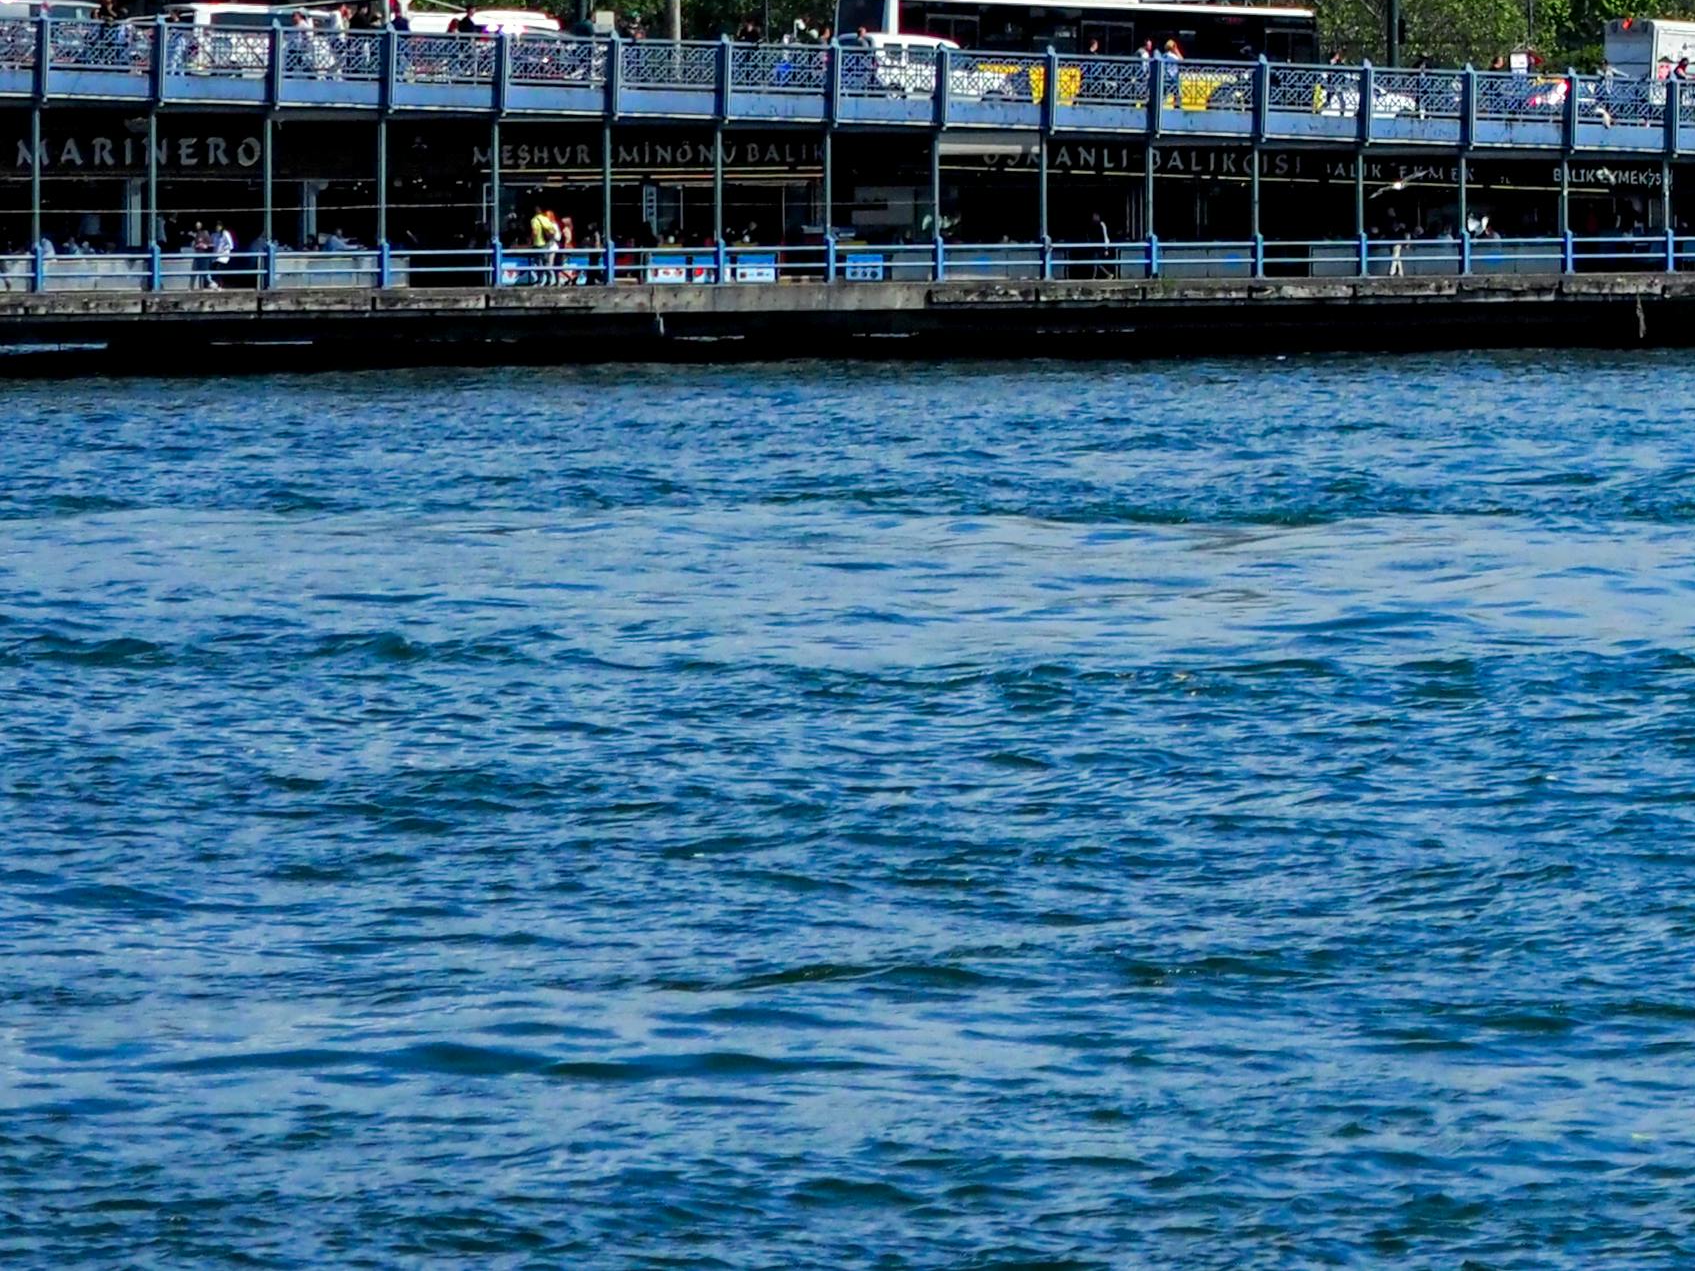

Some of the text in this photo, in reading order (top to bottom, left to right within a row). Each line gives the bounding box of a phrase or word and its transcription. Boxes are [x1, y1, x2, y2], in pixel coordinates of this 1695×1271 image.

[16, 137, 262, 167] MARINERO
[472, 144, 591, 169] MEŞHUR
[610, 141, 736, 164] MİNÖNÜ
